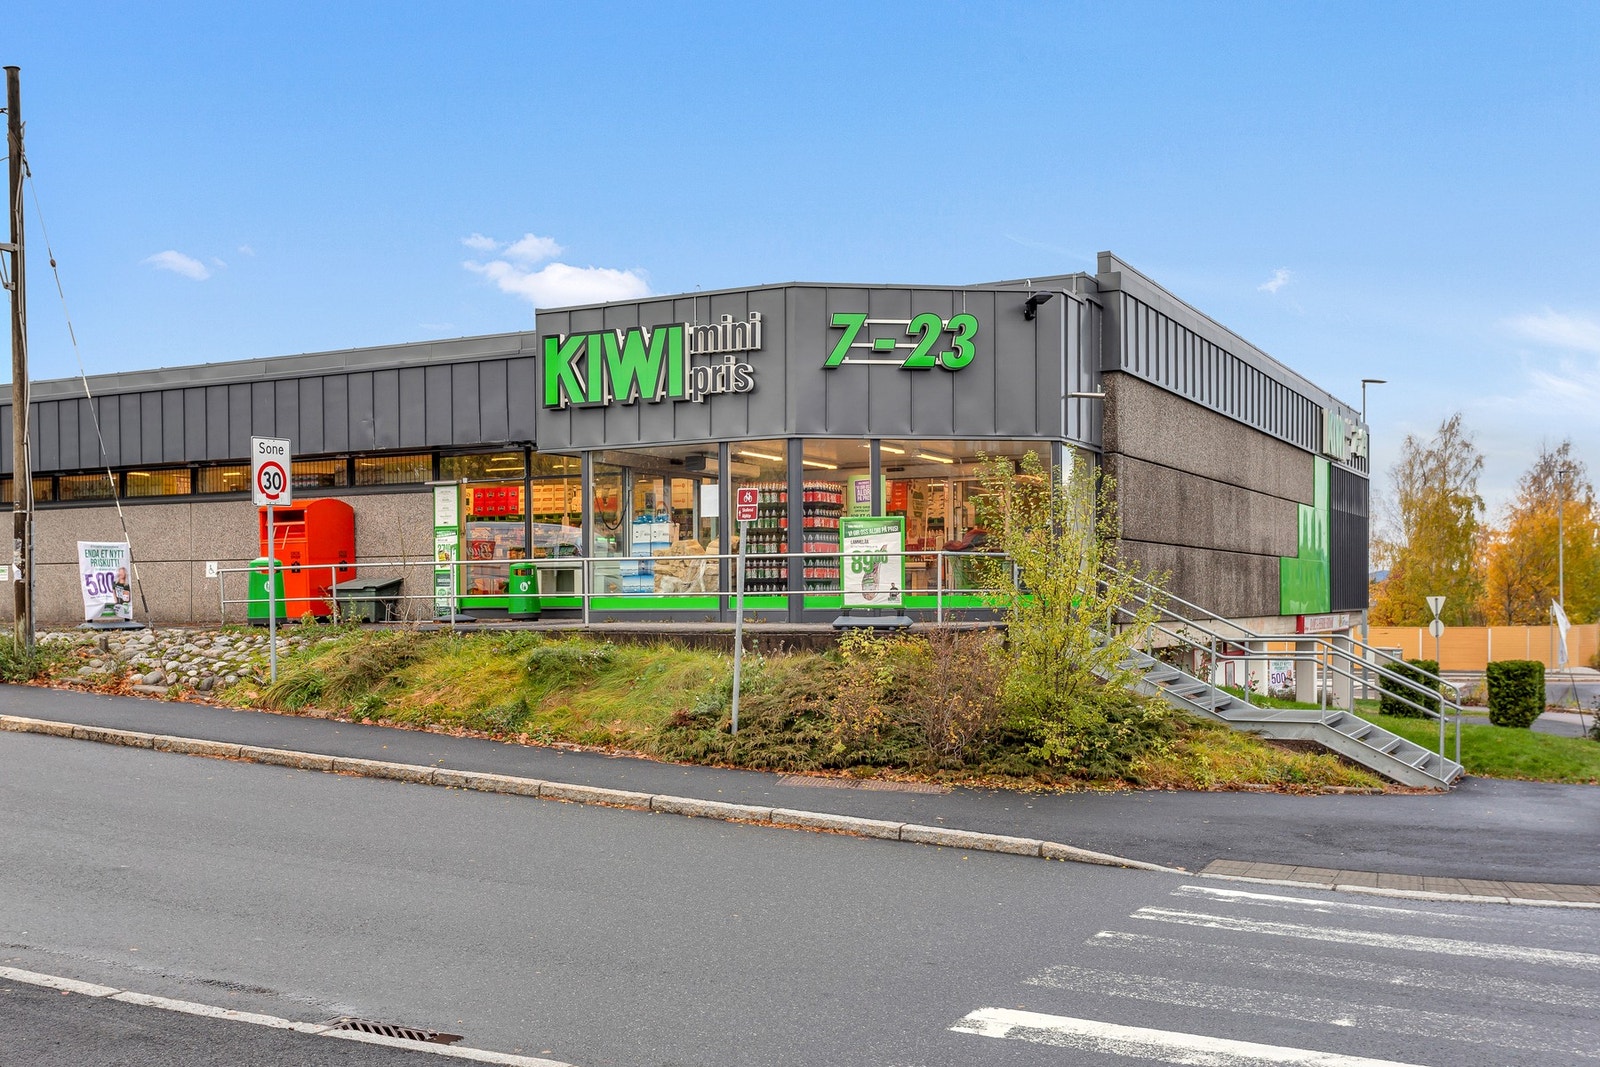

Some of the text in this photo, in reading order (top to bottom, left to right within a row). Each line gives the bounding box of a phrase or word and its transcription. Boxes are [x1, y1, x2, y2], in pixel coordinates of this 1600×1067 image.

[691, 312, 761, 354] mini
[824, 313, 979, 371] 7-23
[541, 321, 690, 410] KIWI
[691, 355, 755, 404] pris
[258, 442, 284, 456] Sone
[263, 471, 282, 490] 30
[85, 549, 124, 558] ENDA ET NYTT
[90, 558, 120, 567] PRISKUTT!
[84, 571, 115, 596] 500
[1271, 672, 1287, 684] 500
